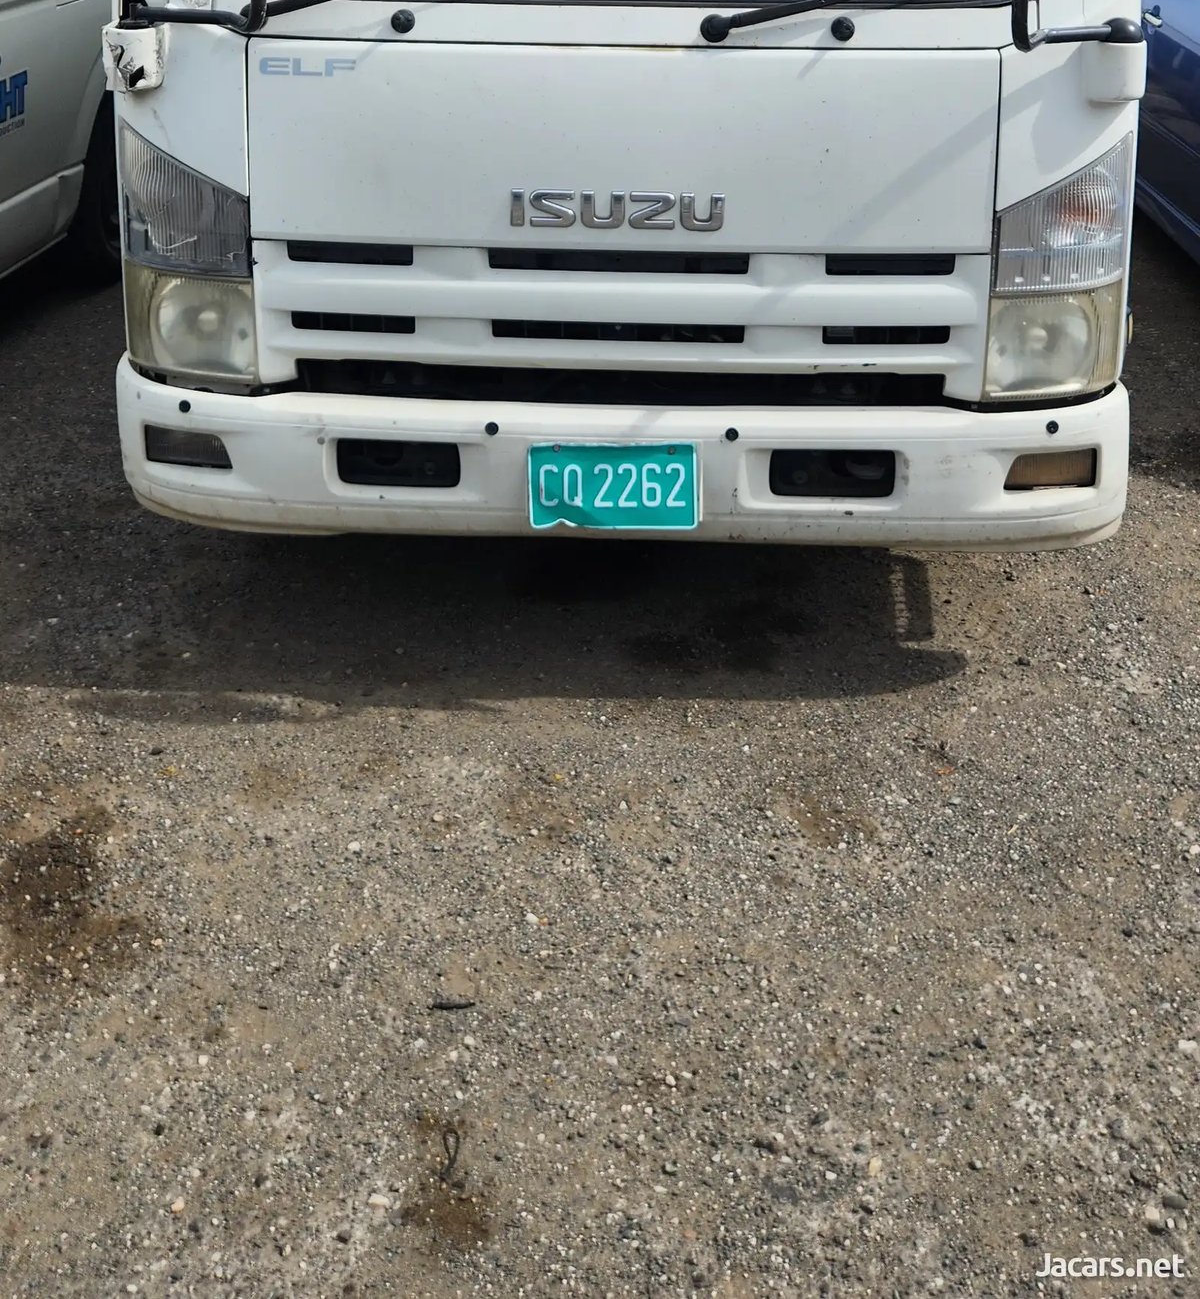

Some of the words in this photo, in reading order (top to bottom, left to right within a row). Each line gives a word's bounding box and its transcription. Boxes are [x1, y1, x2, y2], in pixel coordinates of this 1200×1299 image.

[259, 57, 357, 78] ELF
[510, 188, 726, 232] ISUZU
[539, 463, 583, 508] CQ
[593, 462, 686, 508] 2262
